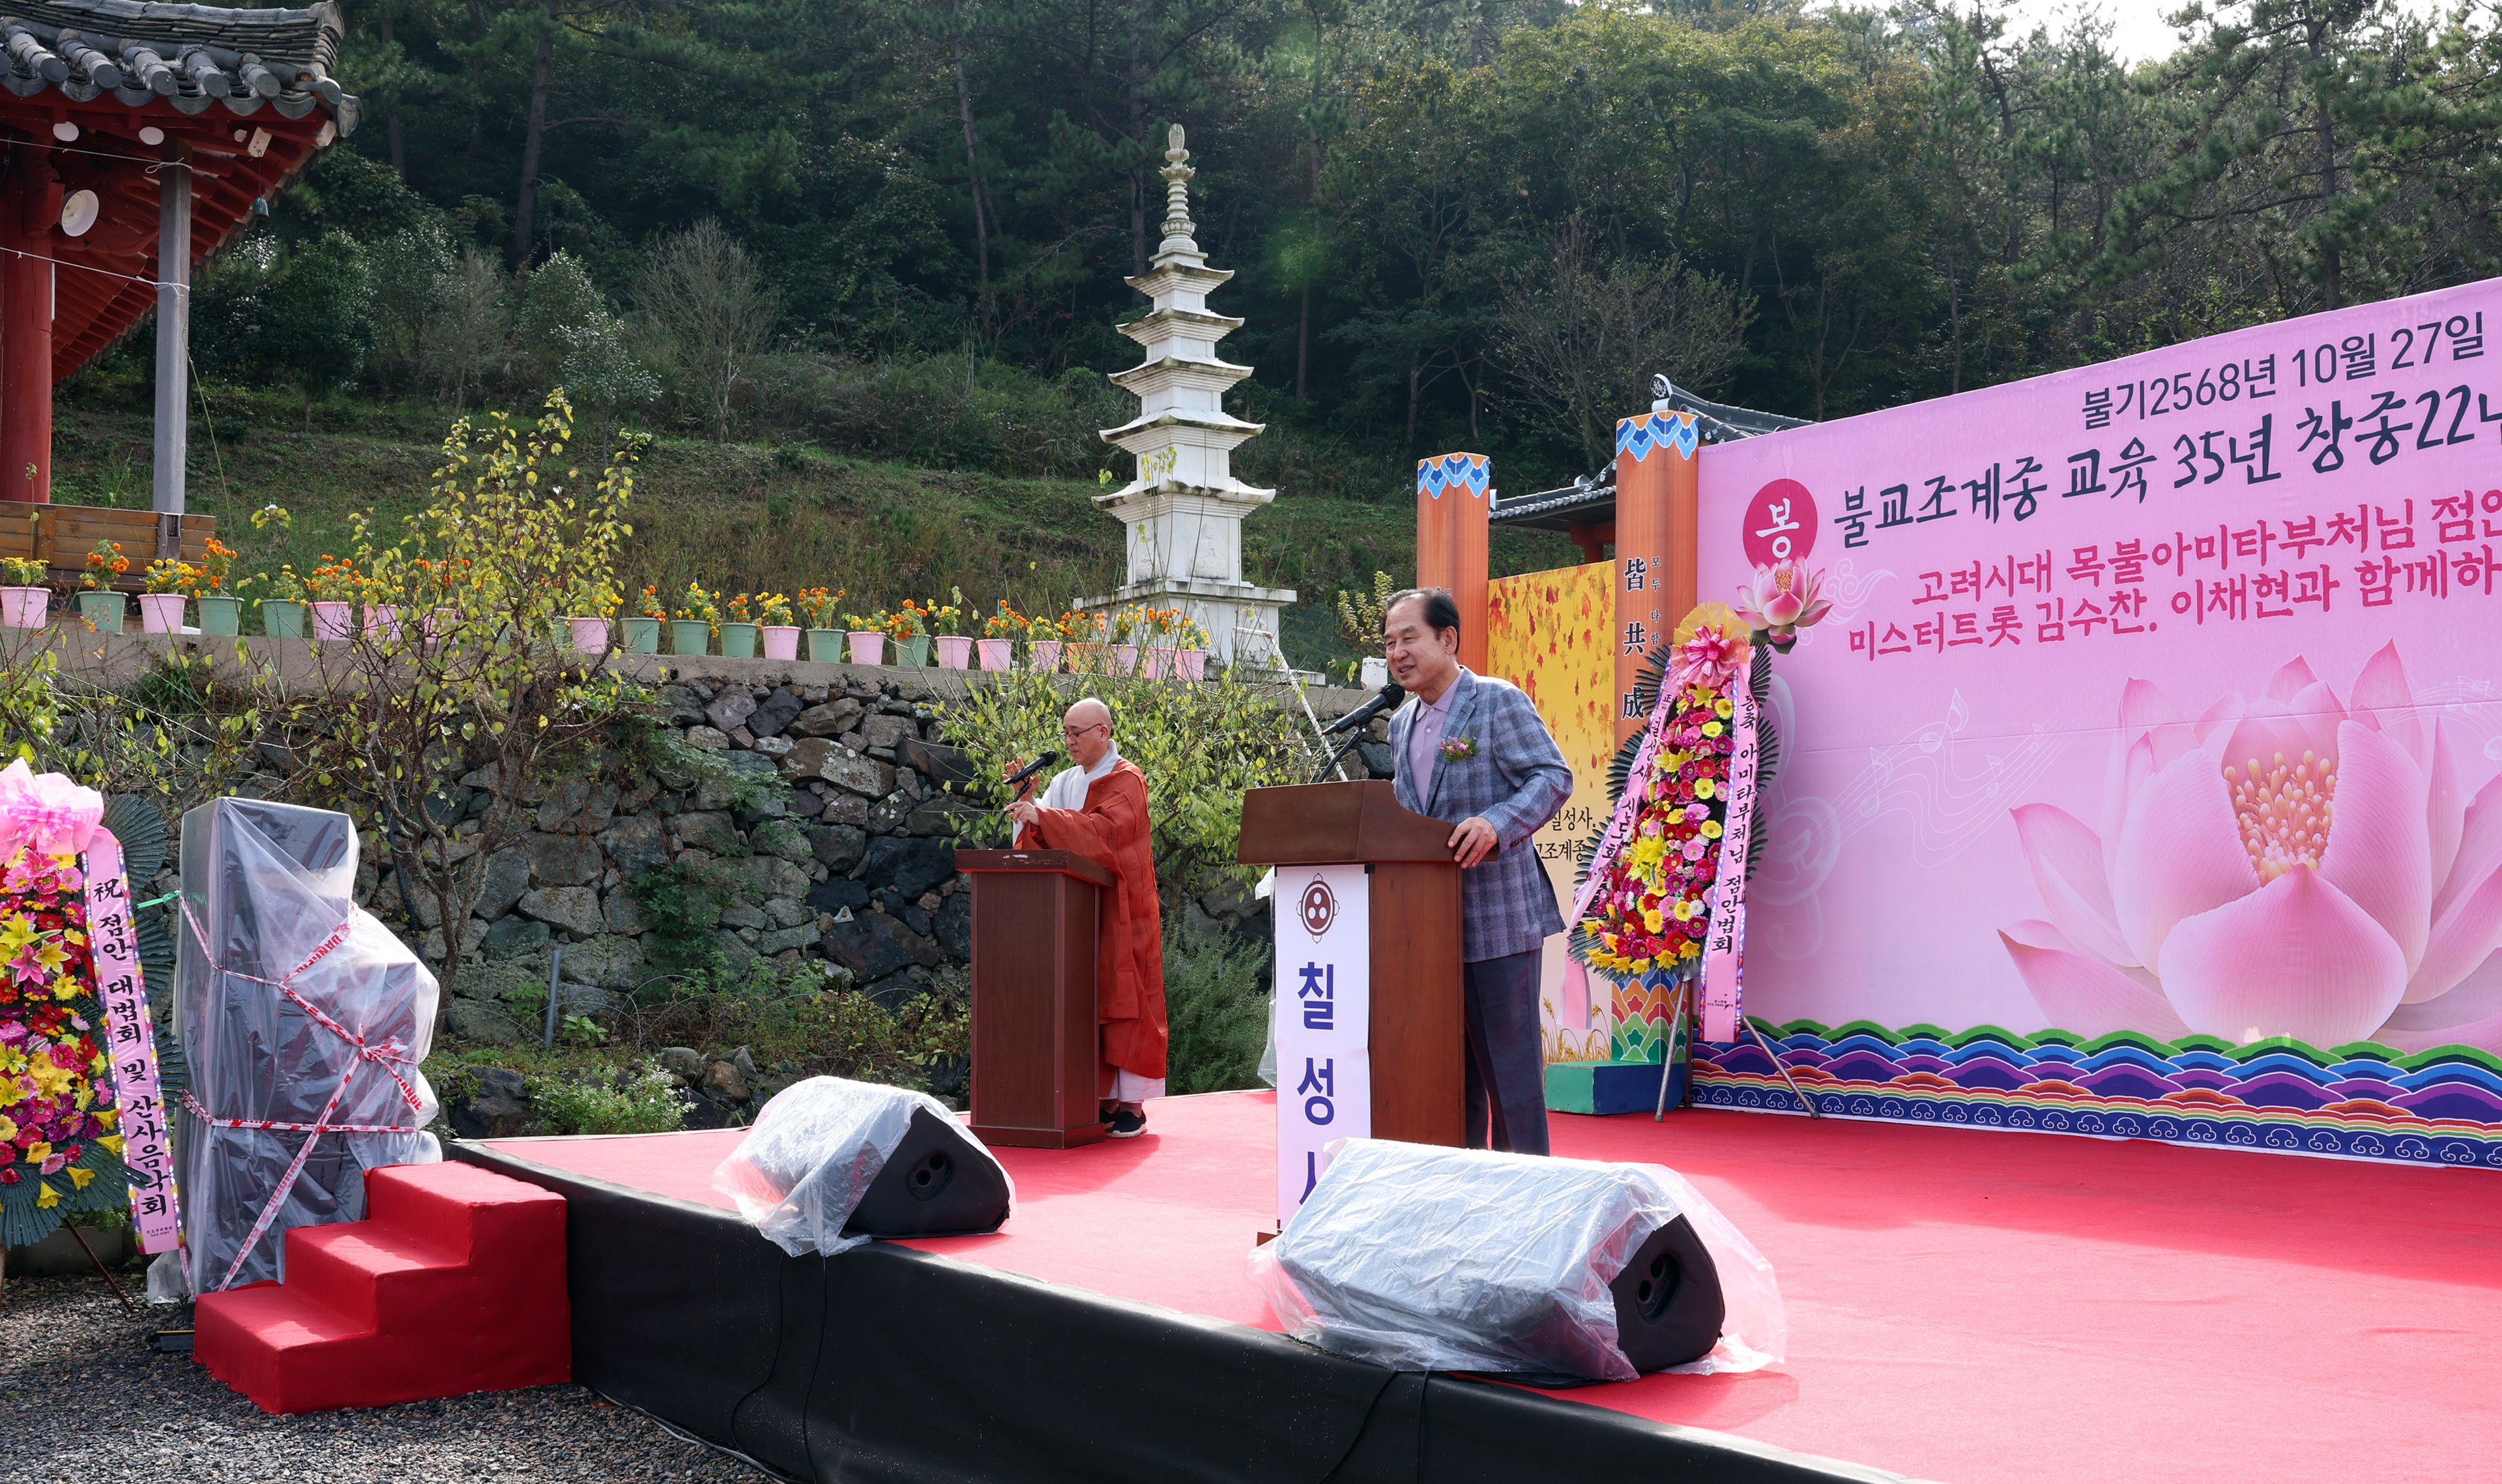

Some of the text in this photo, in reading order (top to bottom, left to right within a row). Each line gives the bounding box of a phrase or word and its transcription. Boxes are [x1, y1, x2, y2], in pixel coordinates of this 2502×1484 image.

[2082, 312, 2484, 430] 불기2568년 10월 27일
[1834, 456, 2048, 549] 불교조계종
[2061, 437, 2158, 504] 교육
[2174, 413, 2282, 489] 35년
[1755, 497, 1800, 559] 봉
[1912, 549, 2052, 605] 고려시대
[2066, 499, 2415, 588] 목불아미타부처님
[1651, 556, 1661, 591] 모두
[1849, 544, 2502, 662] 미스터트롯 김수찬. 이채현과 함께하
[1711, 691, 1758, 955] 봉축 아미타부처님 점안법회
[93, 878, 124, 903] 祝
[98, 913, 133, 961] 점안
[106, 974, 141, 1045] 대법회
[121, 1058, 147, 1084] 및
[1297, 961, 1335, 1205] 칠성
